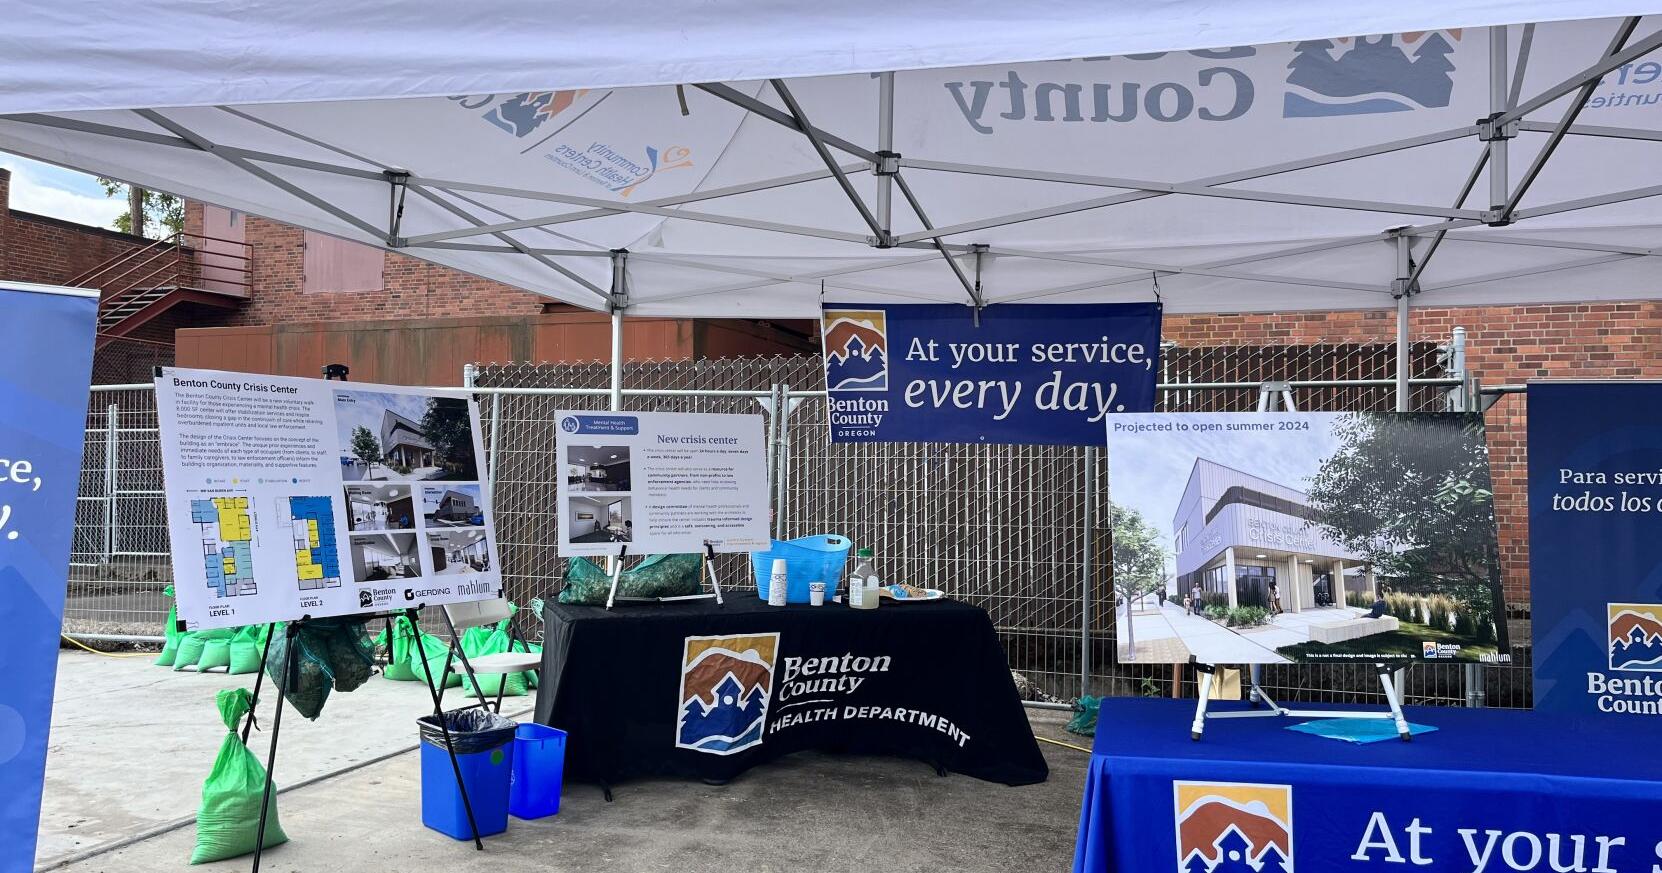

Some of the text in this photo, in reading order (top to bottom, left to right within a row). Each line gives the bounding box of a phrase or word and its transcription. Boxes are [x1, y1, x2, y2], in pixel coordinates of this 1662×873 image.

[905, 336, 1152, 371] At your service,
[173, 378, 298, 394] Benton County Crisis Center
[828, 397, 889, 412] Benton
[904, 371, 1125, 422] every day.
[831, 412, 883, 427] County
[1114, 421, 1311, 433] Projected to open summer 2024
[657, 434, 738, 445] New crisis center
[1559, 468, 1607, 484] Para
[1552, 491, 1615, 511] todos
[1621, 491, 1652, 512] los
[372, 587, 396, 595] Benton
[415, 587, 451, 598] GERDING
[457, 580, 490, 596] mahlum
[1479, 651, 1511, 662] mahlum
[782, 651, 891, 683] Benton
[778, 674, 866, 702] County
[769, 705, 971, 748] HEALTH DEPARTMENT
[1351, 811, 1434, 865] At
[1457, 827, 1627, 873] your
